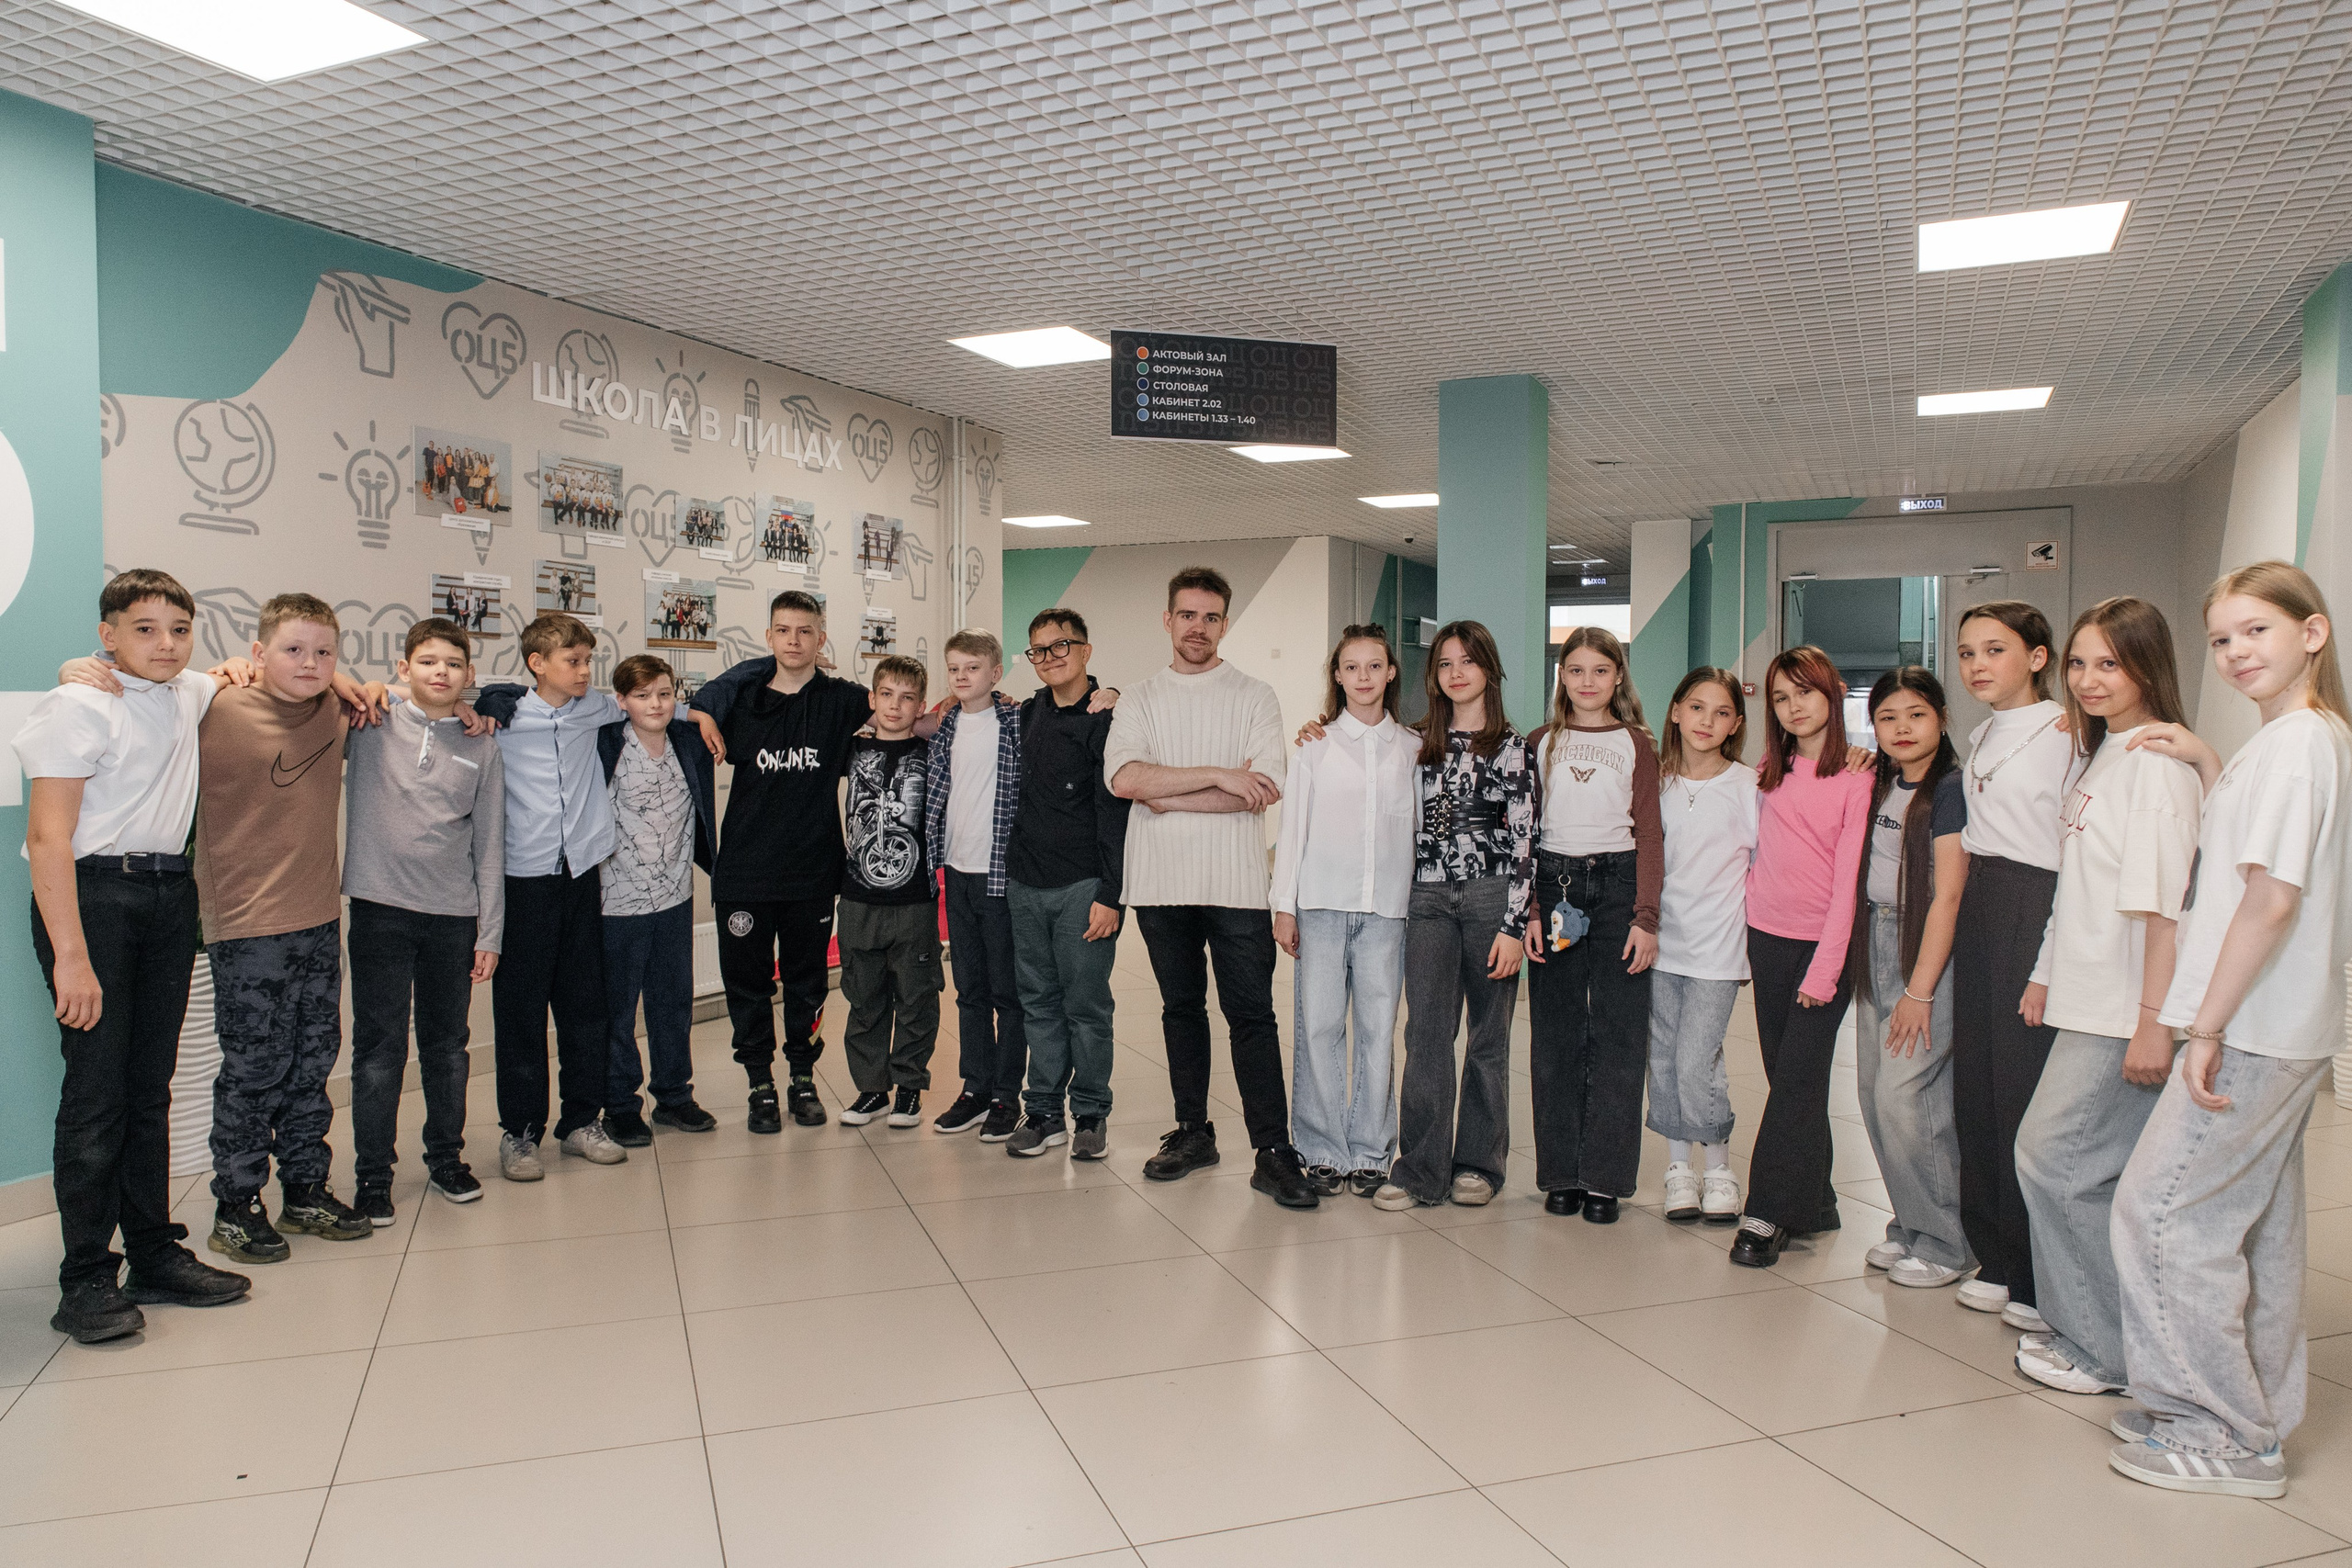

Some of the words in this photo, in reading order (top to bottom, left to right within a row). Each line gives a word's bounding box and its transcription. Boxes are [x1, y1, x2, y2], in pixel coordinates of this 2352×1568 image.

[1152, 350, 1204, 361] АКТОВЫЙ
[1205, 353, 1227, 363] ЗАЛ
[1152, 365, 1224, 378] ФОРУМ-ЗОНА
[1152, 381, 1209, 392] СТОЛОВАЯ
[1152, 396, 1201, 408] КАБИНЕТ
[1202, 399, 1222, 409] 2.02
[532, 361, 689, 436] ШКОЛА
[699, 404, 721, 442] В
[730, 413, 843, 472] ЛИЦАХ
[1152, 411, 1209, 423] КАБИНЕТЫ
[1211, 413, 1229, 423] 1.33
[1237, 415, 1256, 424] 1.40
[1903, 499, 1943, 511] ВЫХОД
[756, 746, 820, 774] ONLINE
